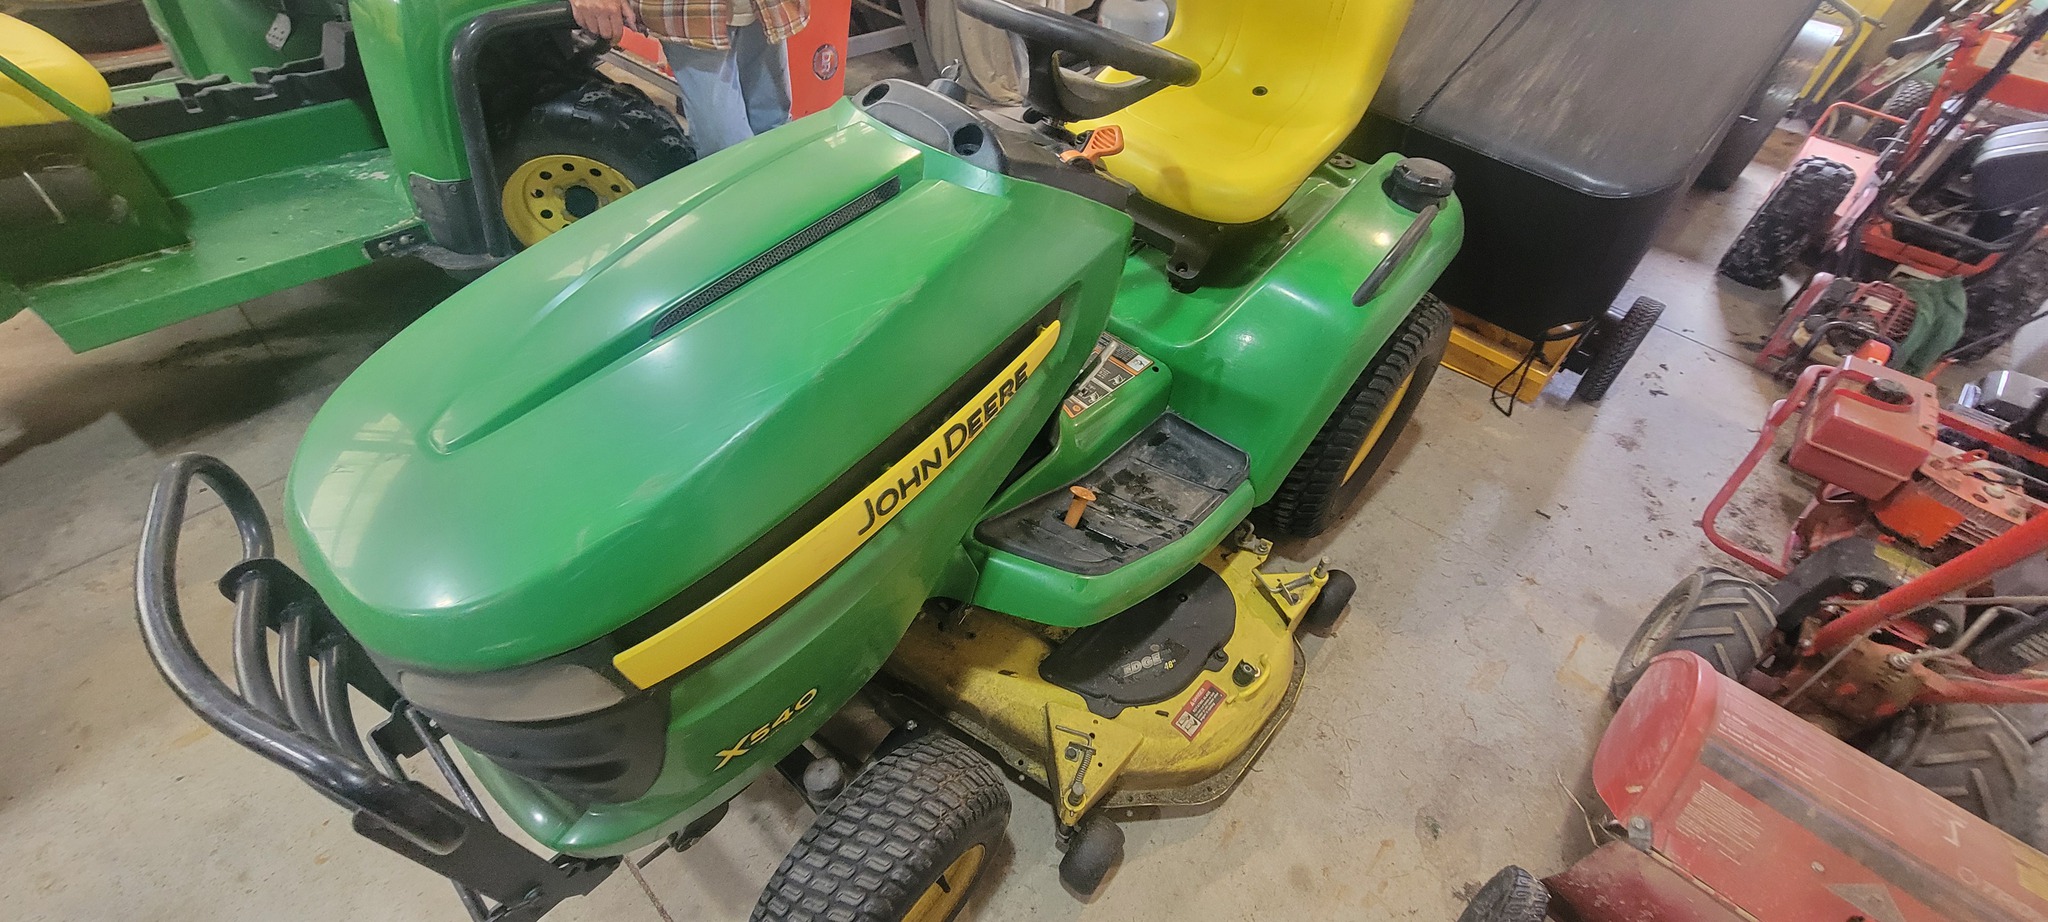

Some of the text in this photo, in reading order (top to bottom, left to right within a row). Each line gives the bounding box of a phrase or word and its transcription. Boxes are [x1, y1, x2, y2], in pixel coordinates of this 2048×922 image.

[858, 361, 1029, 536] JOHN DEERE
[1121, 652, 1162, 678] EDGE
[713, 688, 818, 772] X540
